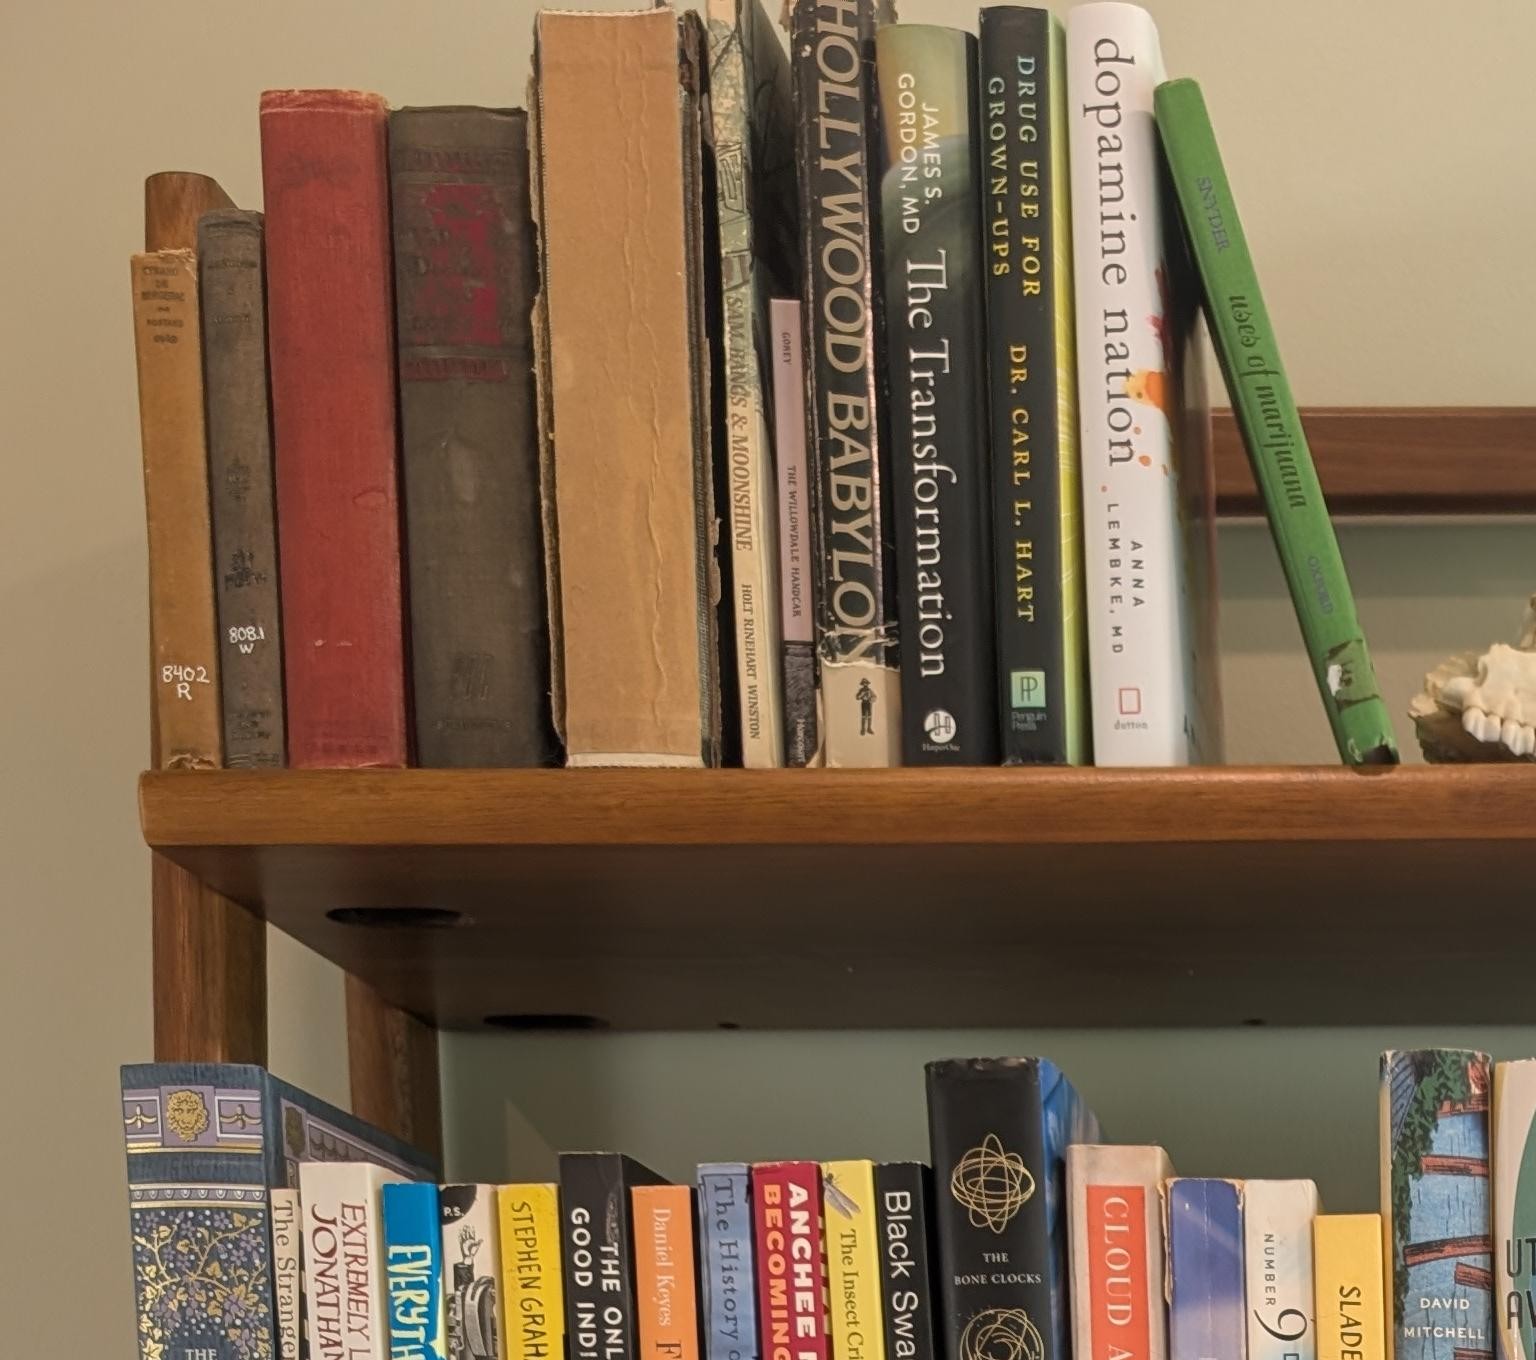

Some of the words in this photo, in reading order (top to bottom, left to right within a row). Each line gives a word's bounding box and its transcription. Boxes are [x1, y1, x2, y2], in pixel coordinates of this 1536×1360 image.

[1016, 56, 1037, 142] DRUG
[814, 0, 874, 373] HOLLYWOOD
[988, 78, 1009, 277] GROWN-UPS
[1020, 154, 1039, 218] USE
[1083, 38, 1136, 287] dopamine
[1194, 175, 1231, 254] SNYDER
[905, 249, 946, 329] The
[1022, 228, 1041, 297] FOR
[1228, 294, 1255, 348] uses
[1103, 308, 1134, 468] nation
[1247, 349, 1280, 378] of
[786, 466, 796, 486] THE
[1255, 383, 1306, 510] marijuana
[732, 438, 751, 551] MOONSHINE
[788, 490, 800, 564] WILLOWDALE
[909, 339, 957, 677] Transformation
[827, 394, 876, 664] BABYLON
[1108, 503, 1123, 612] LEMBKE,
[742, 584, 754, 614] HOLT
[791, 568, 802, 618] HANDCAR
[1130, 541, 1144, 608] ANNA
[239, 643, 254, 654] W
[744, 619, 757, 680] RINEHART
[1111, 625, 1124, 654] MD
[177, 682, 192, 701] R
[747, 684, 760, 739] WINSTON
[273, 1200, 289, 1246] The
[443, 1207, 464, 1217] P.S.
[511, 1201, 541, 1290] STEPHEN
[840, 1229, 857, 1266] The
[983, 1253, 1009, 1263] THE
[1103, 1197, 1133, 1326] CLOUD
[1264, 1234, 1277, 1306] NUMBER
[844, 1271, 859, 1329] Insect
[954, 1275, 987, 1285] BONE
[991, 1274, 1042, 1284] CLOCKS
[1253, 1308, 1307, 1341] 9
